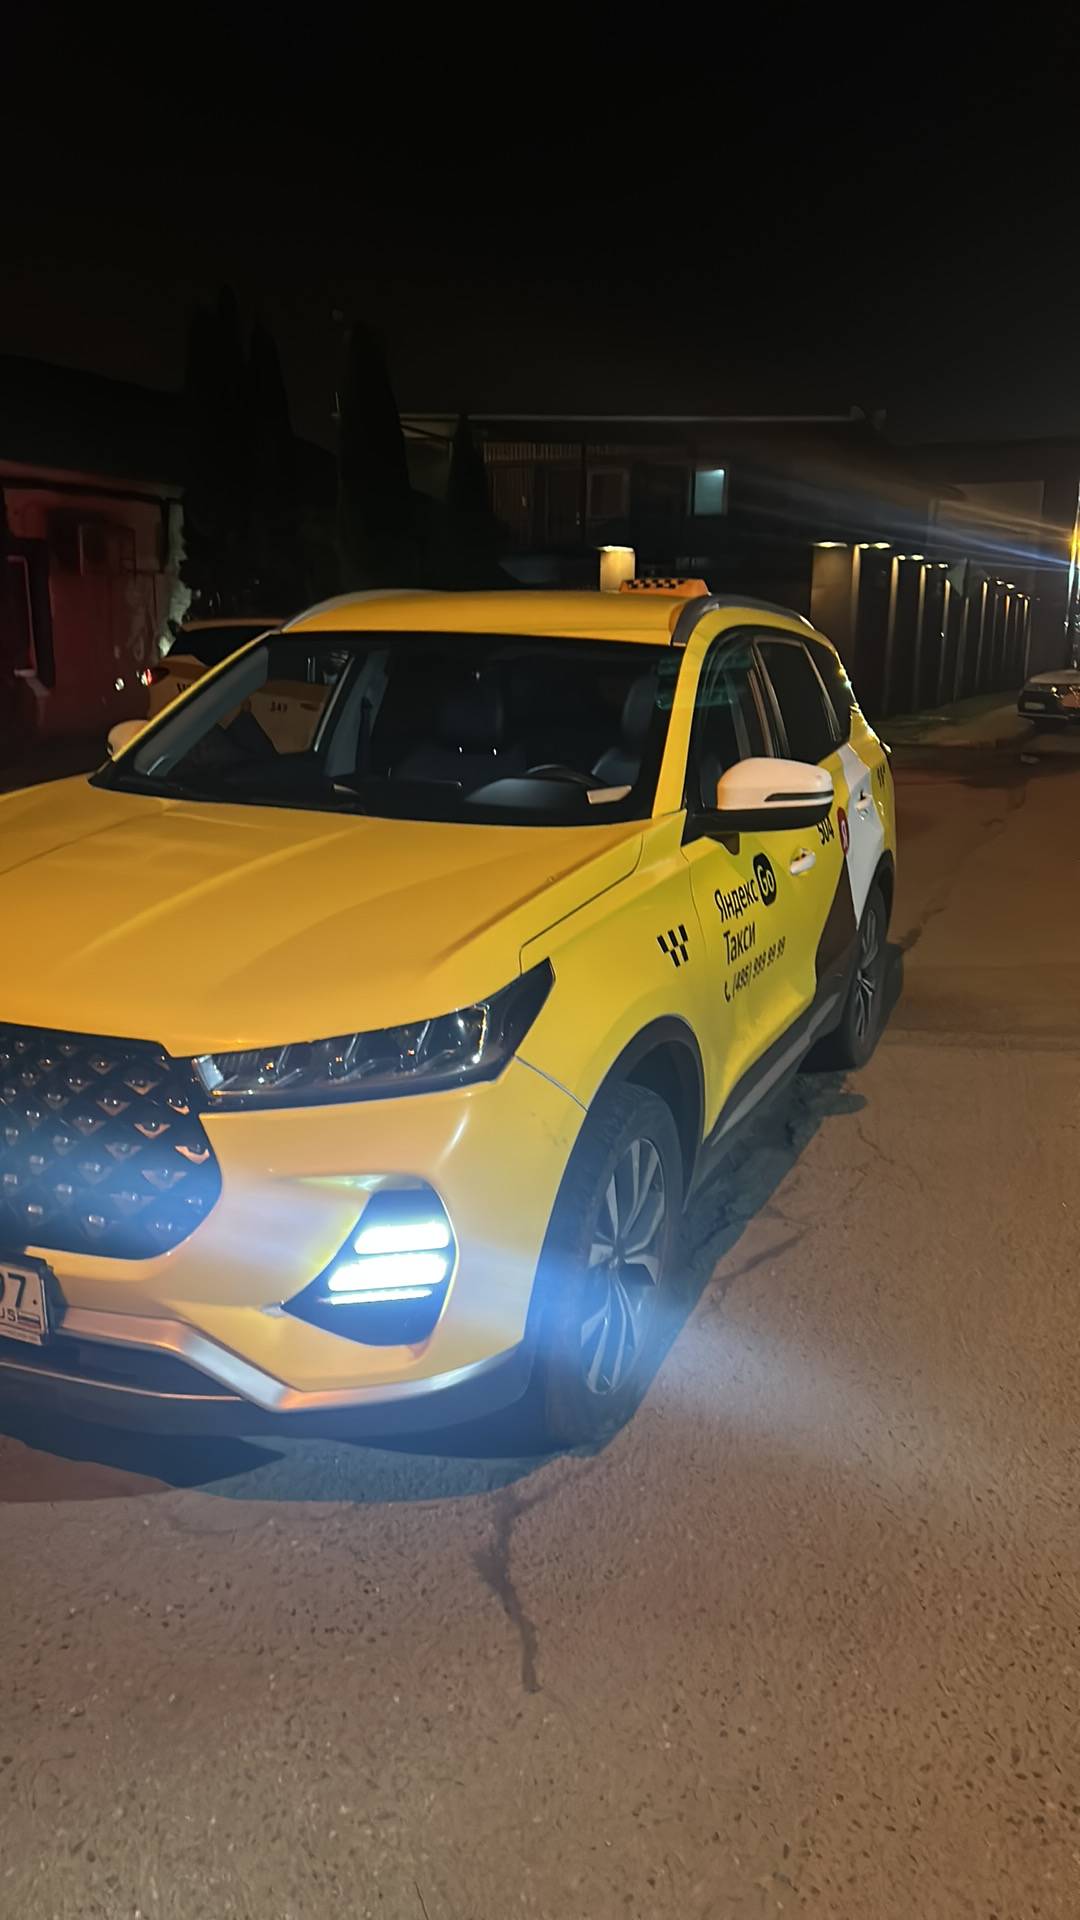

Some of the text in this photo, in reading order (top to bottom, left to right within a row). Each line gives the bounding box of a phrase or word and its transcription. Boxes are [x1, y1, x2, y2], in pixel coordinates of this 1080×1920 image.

[714, 865, 775, 923] Яндекс Go
[723, 921, 756, 965] Такси
